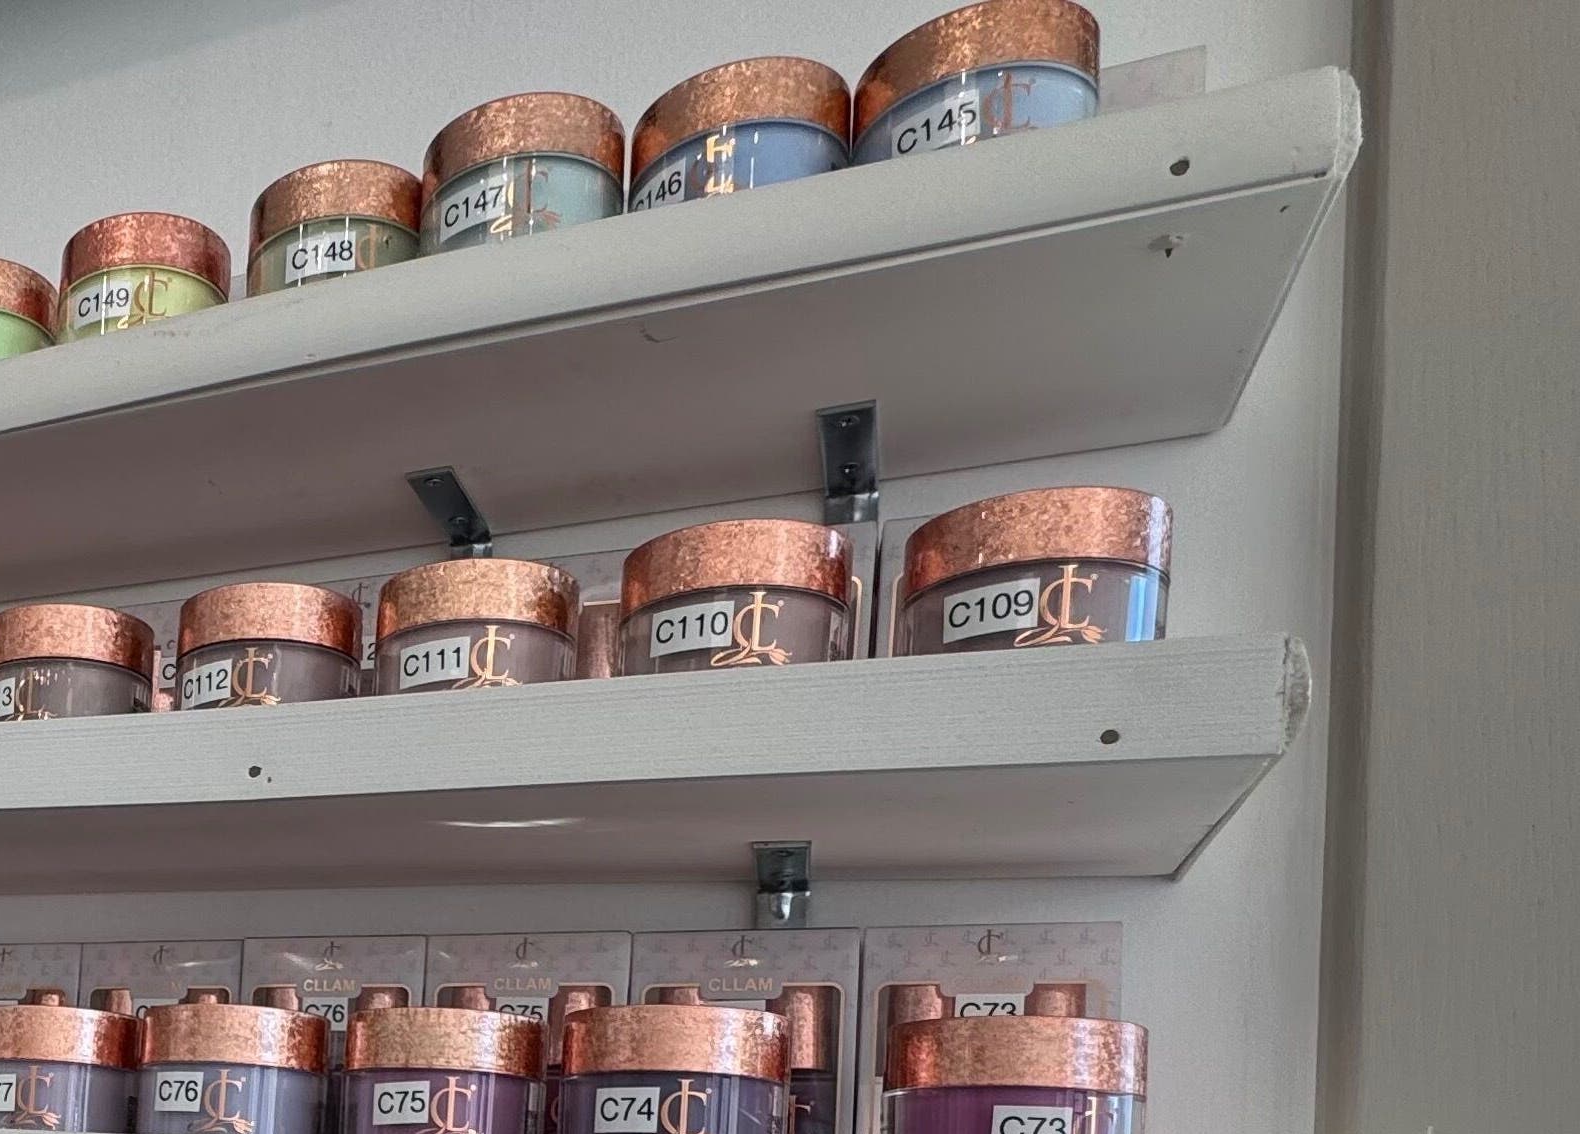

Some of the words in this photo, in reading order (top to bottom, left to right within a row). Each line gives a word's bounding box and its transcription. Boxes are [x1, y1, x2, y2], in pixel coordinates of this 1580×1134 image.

[896, 101, 976, 155] C145
[444, 185, 504, 229] C147
[291, 240, 354, 271] C148
[77, 287, 131, 318] C149
[948, 588, 1035, 630] C109
[655, 610, 729, 645] C110
[403, 646, 463, 678] C111
[183, 669, 228, 700] C112
[303, 979, 355, 992] CLLAM
[494, 978, 552, 991] CLLAM
[709, 978, 773, 992] CLLAM
[158, 1080, 199, 1102] C76
[377, 1091, 425, 1115] C75
[600, 1098, 654, 1122] C74
